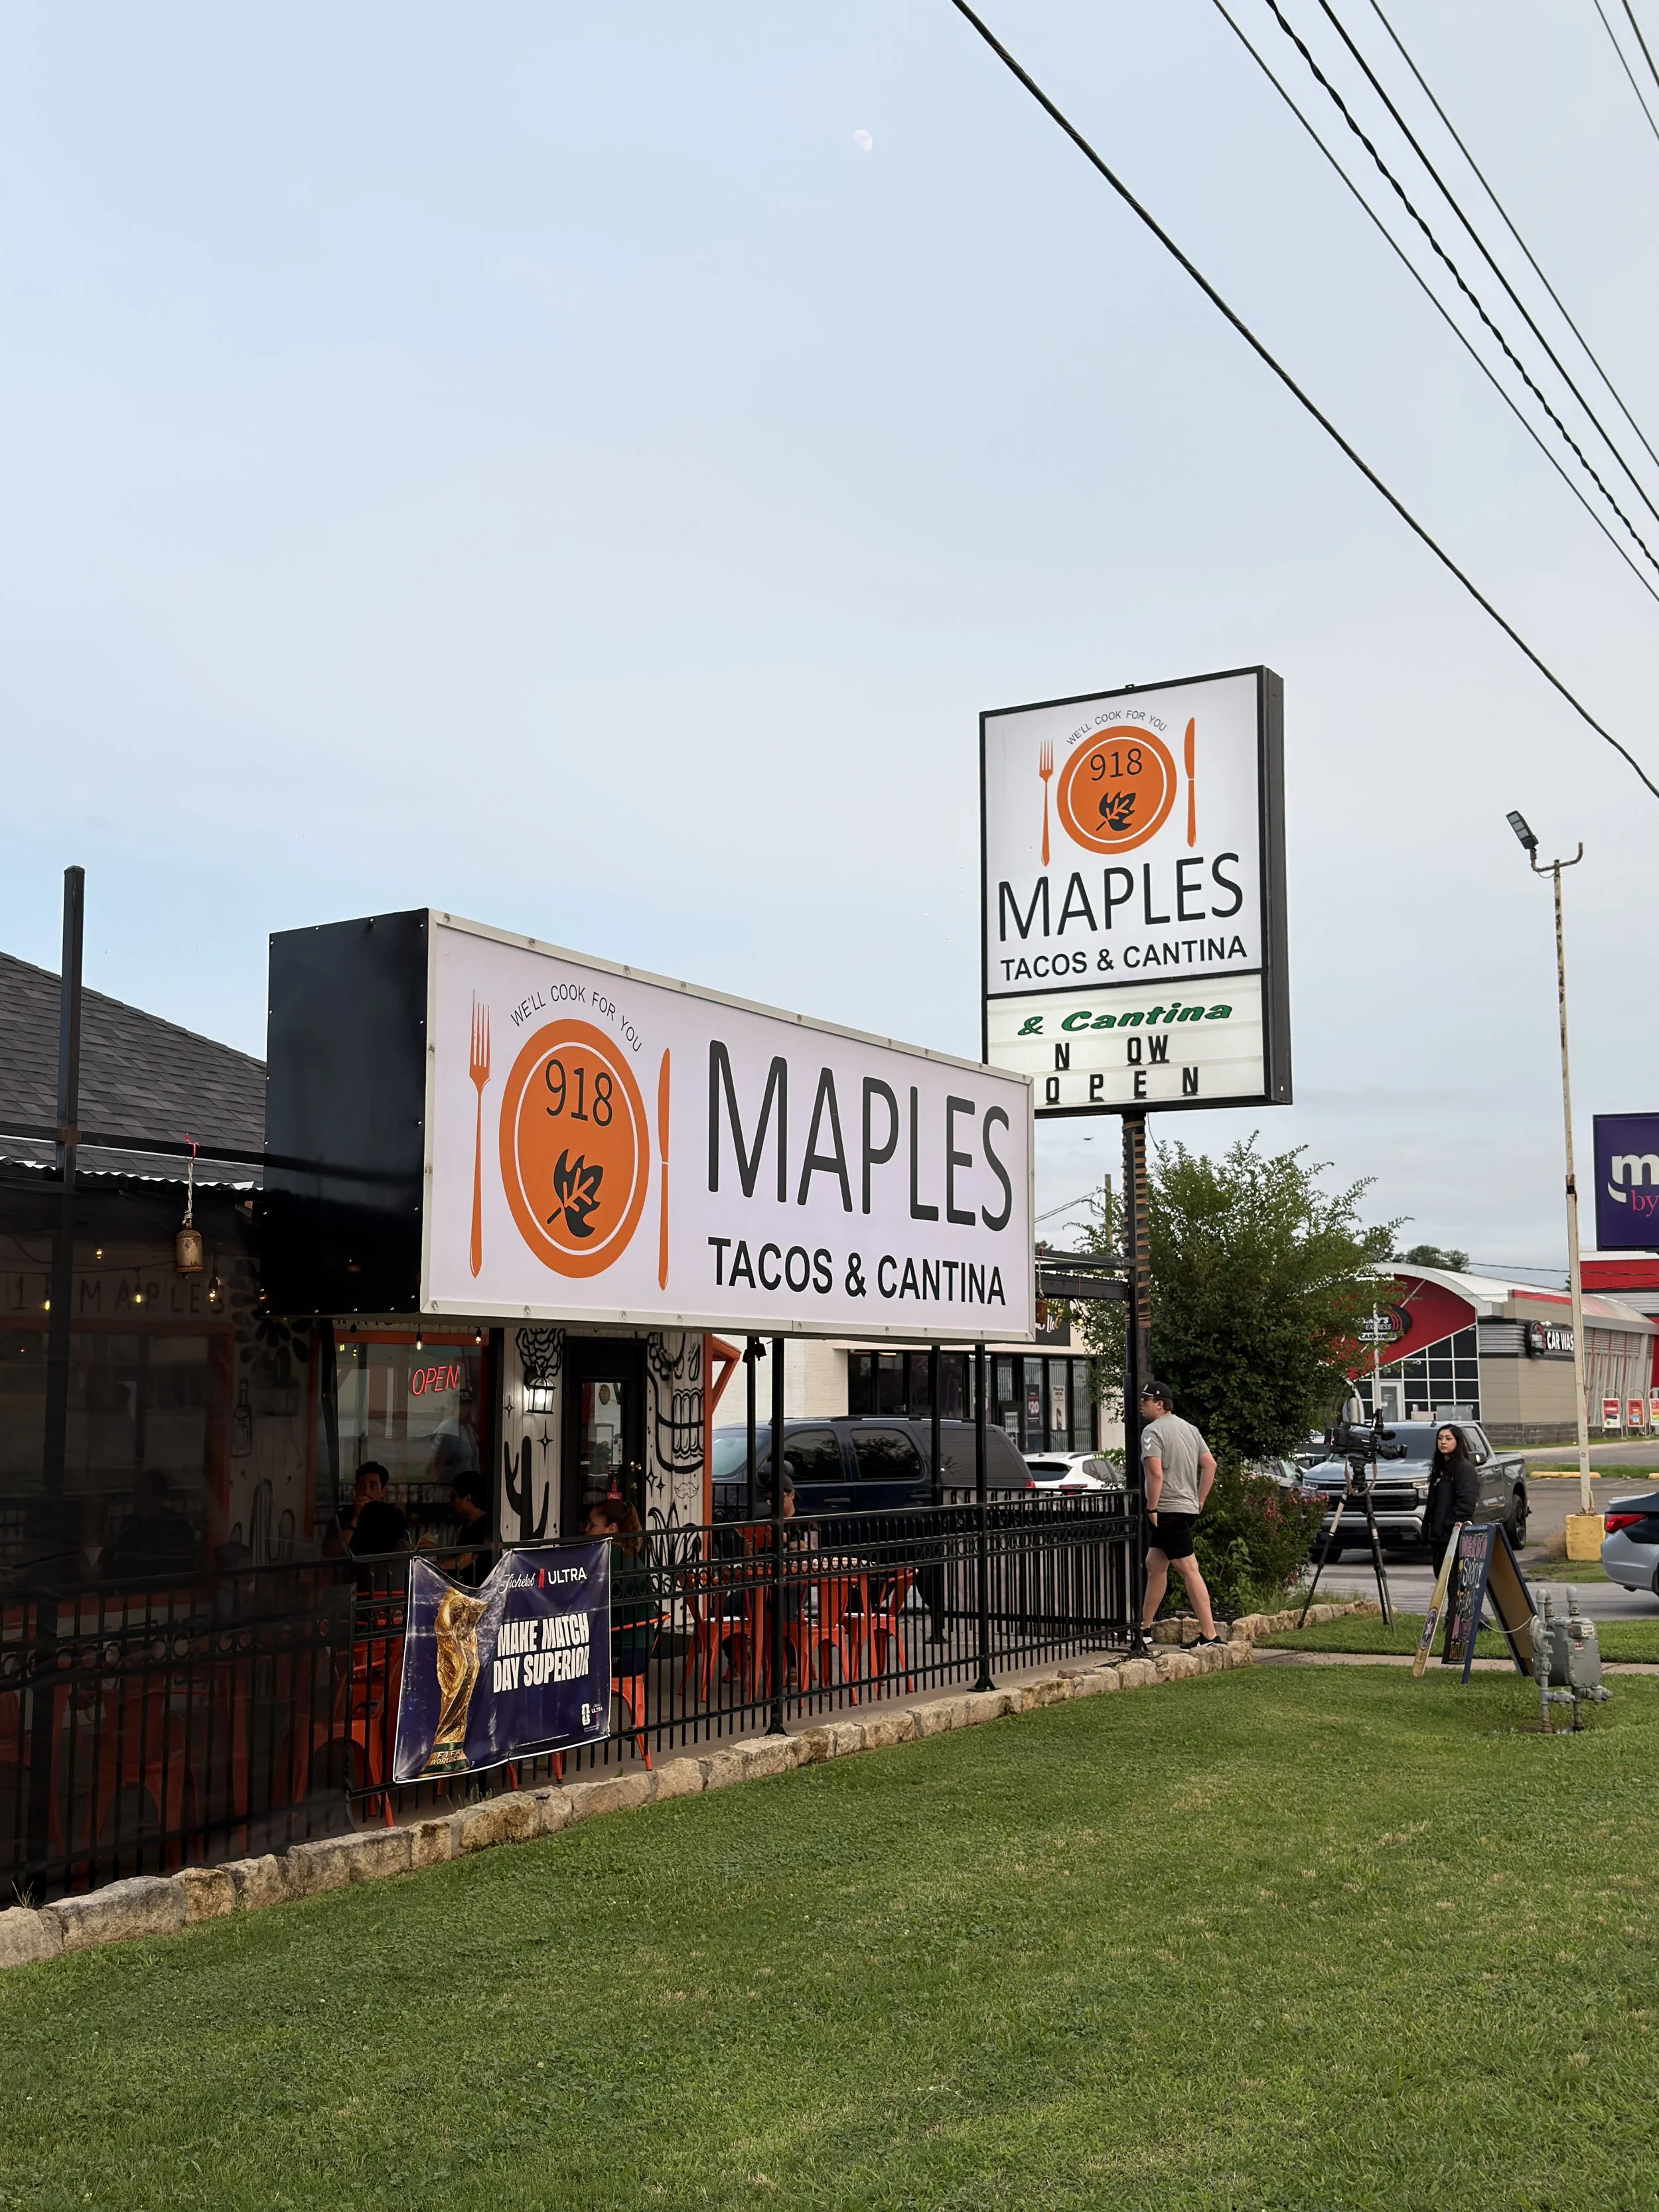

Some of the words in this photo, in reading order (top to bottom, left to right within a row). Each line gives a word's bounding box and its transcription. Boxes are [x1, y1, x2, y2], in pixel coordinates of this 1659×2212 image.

[1066, 723, 1092, 745] WE'LL
[1095, 711, 1121, 725] COOK
[1126, 710, 1145, 721] FOR
[1149, 715, 1167, 732] YOU
[1090, 748, 1142, 782] 918
[999, 852, 1243, 942] MAPLES
[1001, 951, 1088, 981] TACOS
[1096, 949, 1114, 971] &
[1123, 935, 1248, 968] CANTINA
[510, 992, 546, 1027] WE'LL
[551, 984, 586, 1003] COOK
[591, 991, 616, 1021] FOR
[620, 1015, 642, 1052] YOU
[1017, 1016, 1044, 1036] &
[1061, 1002, 1232, 1032] Cantina
[545, 1059, 613, 1127] 918
[708, 1038, 1012, 1233] MAPLES
[1630, 1190, 1659, 1217] by
[707, 1236, 833, 1294] TACOS
[845, 1251, 867, 1298] &
[877, 1255, 1006, 1306] CANTINA
[1546, 1330, 1560, 1350] CAR
[1560, 1332, 1574, 1351] WAS
[412, 1364, 460, 1396] OPEN
[547, 1566, 587, 1584] ULTRA
[497, 1620, 538, 1657] MAKE
[541, 1612, 589, 1650] MATCH
[493, 1656, 520, 1693] DAY
[524, 1645, 590, 1687] SUPERIOR
[437, 1750, 460, 1759] FIFA
